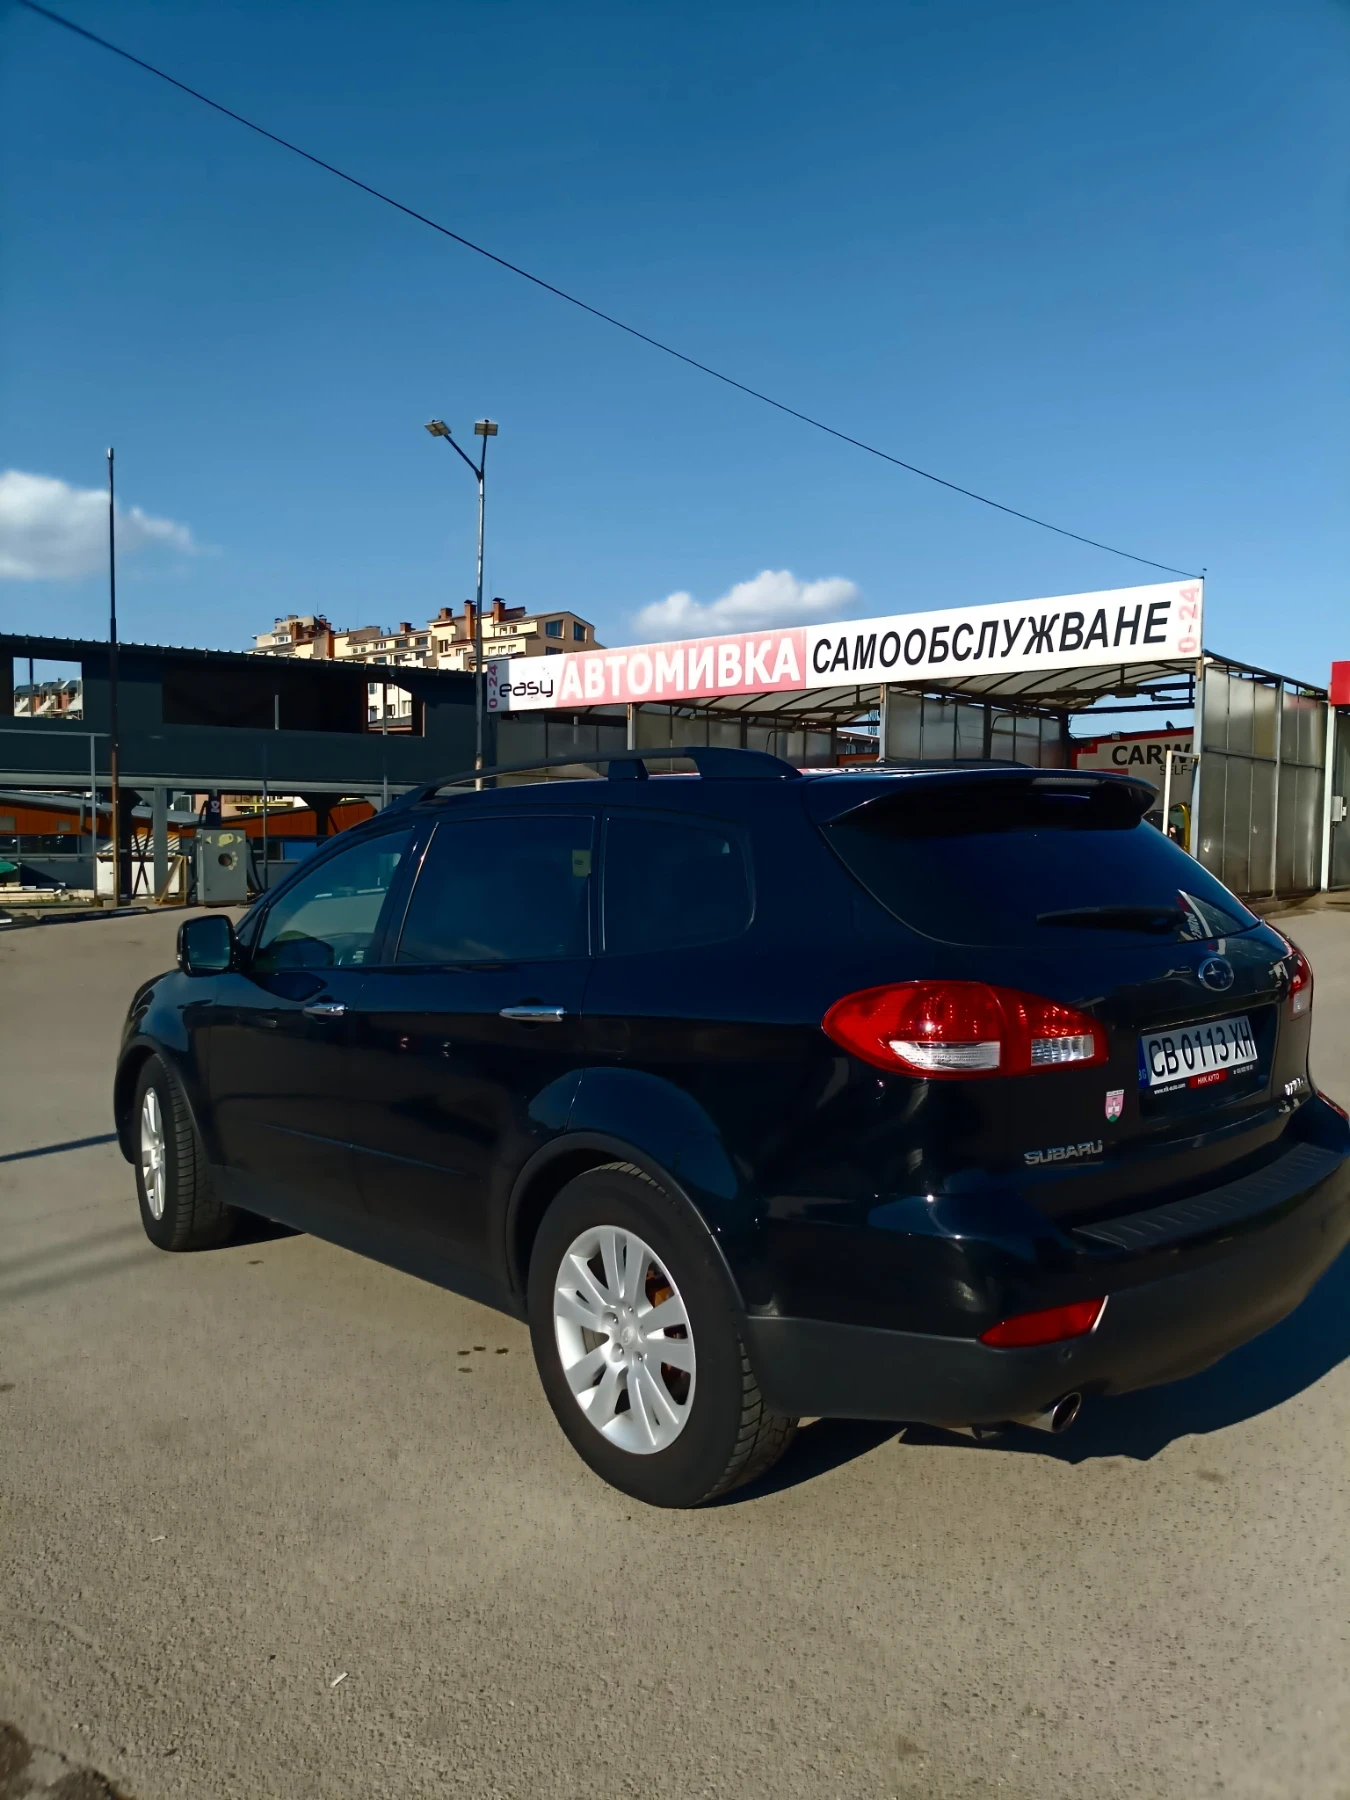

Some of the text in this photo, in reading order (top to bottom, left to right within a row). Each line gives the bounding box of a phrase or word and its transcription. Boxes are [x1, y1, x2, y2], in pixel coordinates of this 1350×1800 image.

[812, 600, 1172, 674] САМООБСЛУЖВАНЕ
[1178, 587, 1200, 653] 0-24
[488, 664, 498, 709] 0-24
[499, 679, 554, 698] easy
[560, 637, 801, 700] АВТОМИВКА
[1112, 743, 1193, 766] CARW
[1148, 1020, 1255, 1077] CB 0113 XH
[1023, 1139, 1103, 1166] SUBARU
